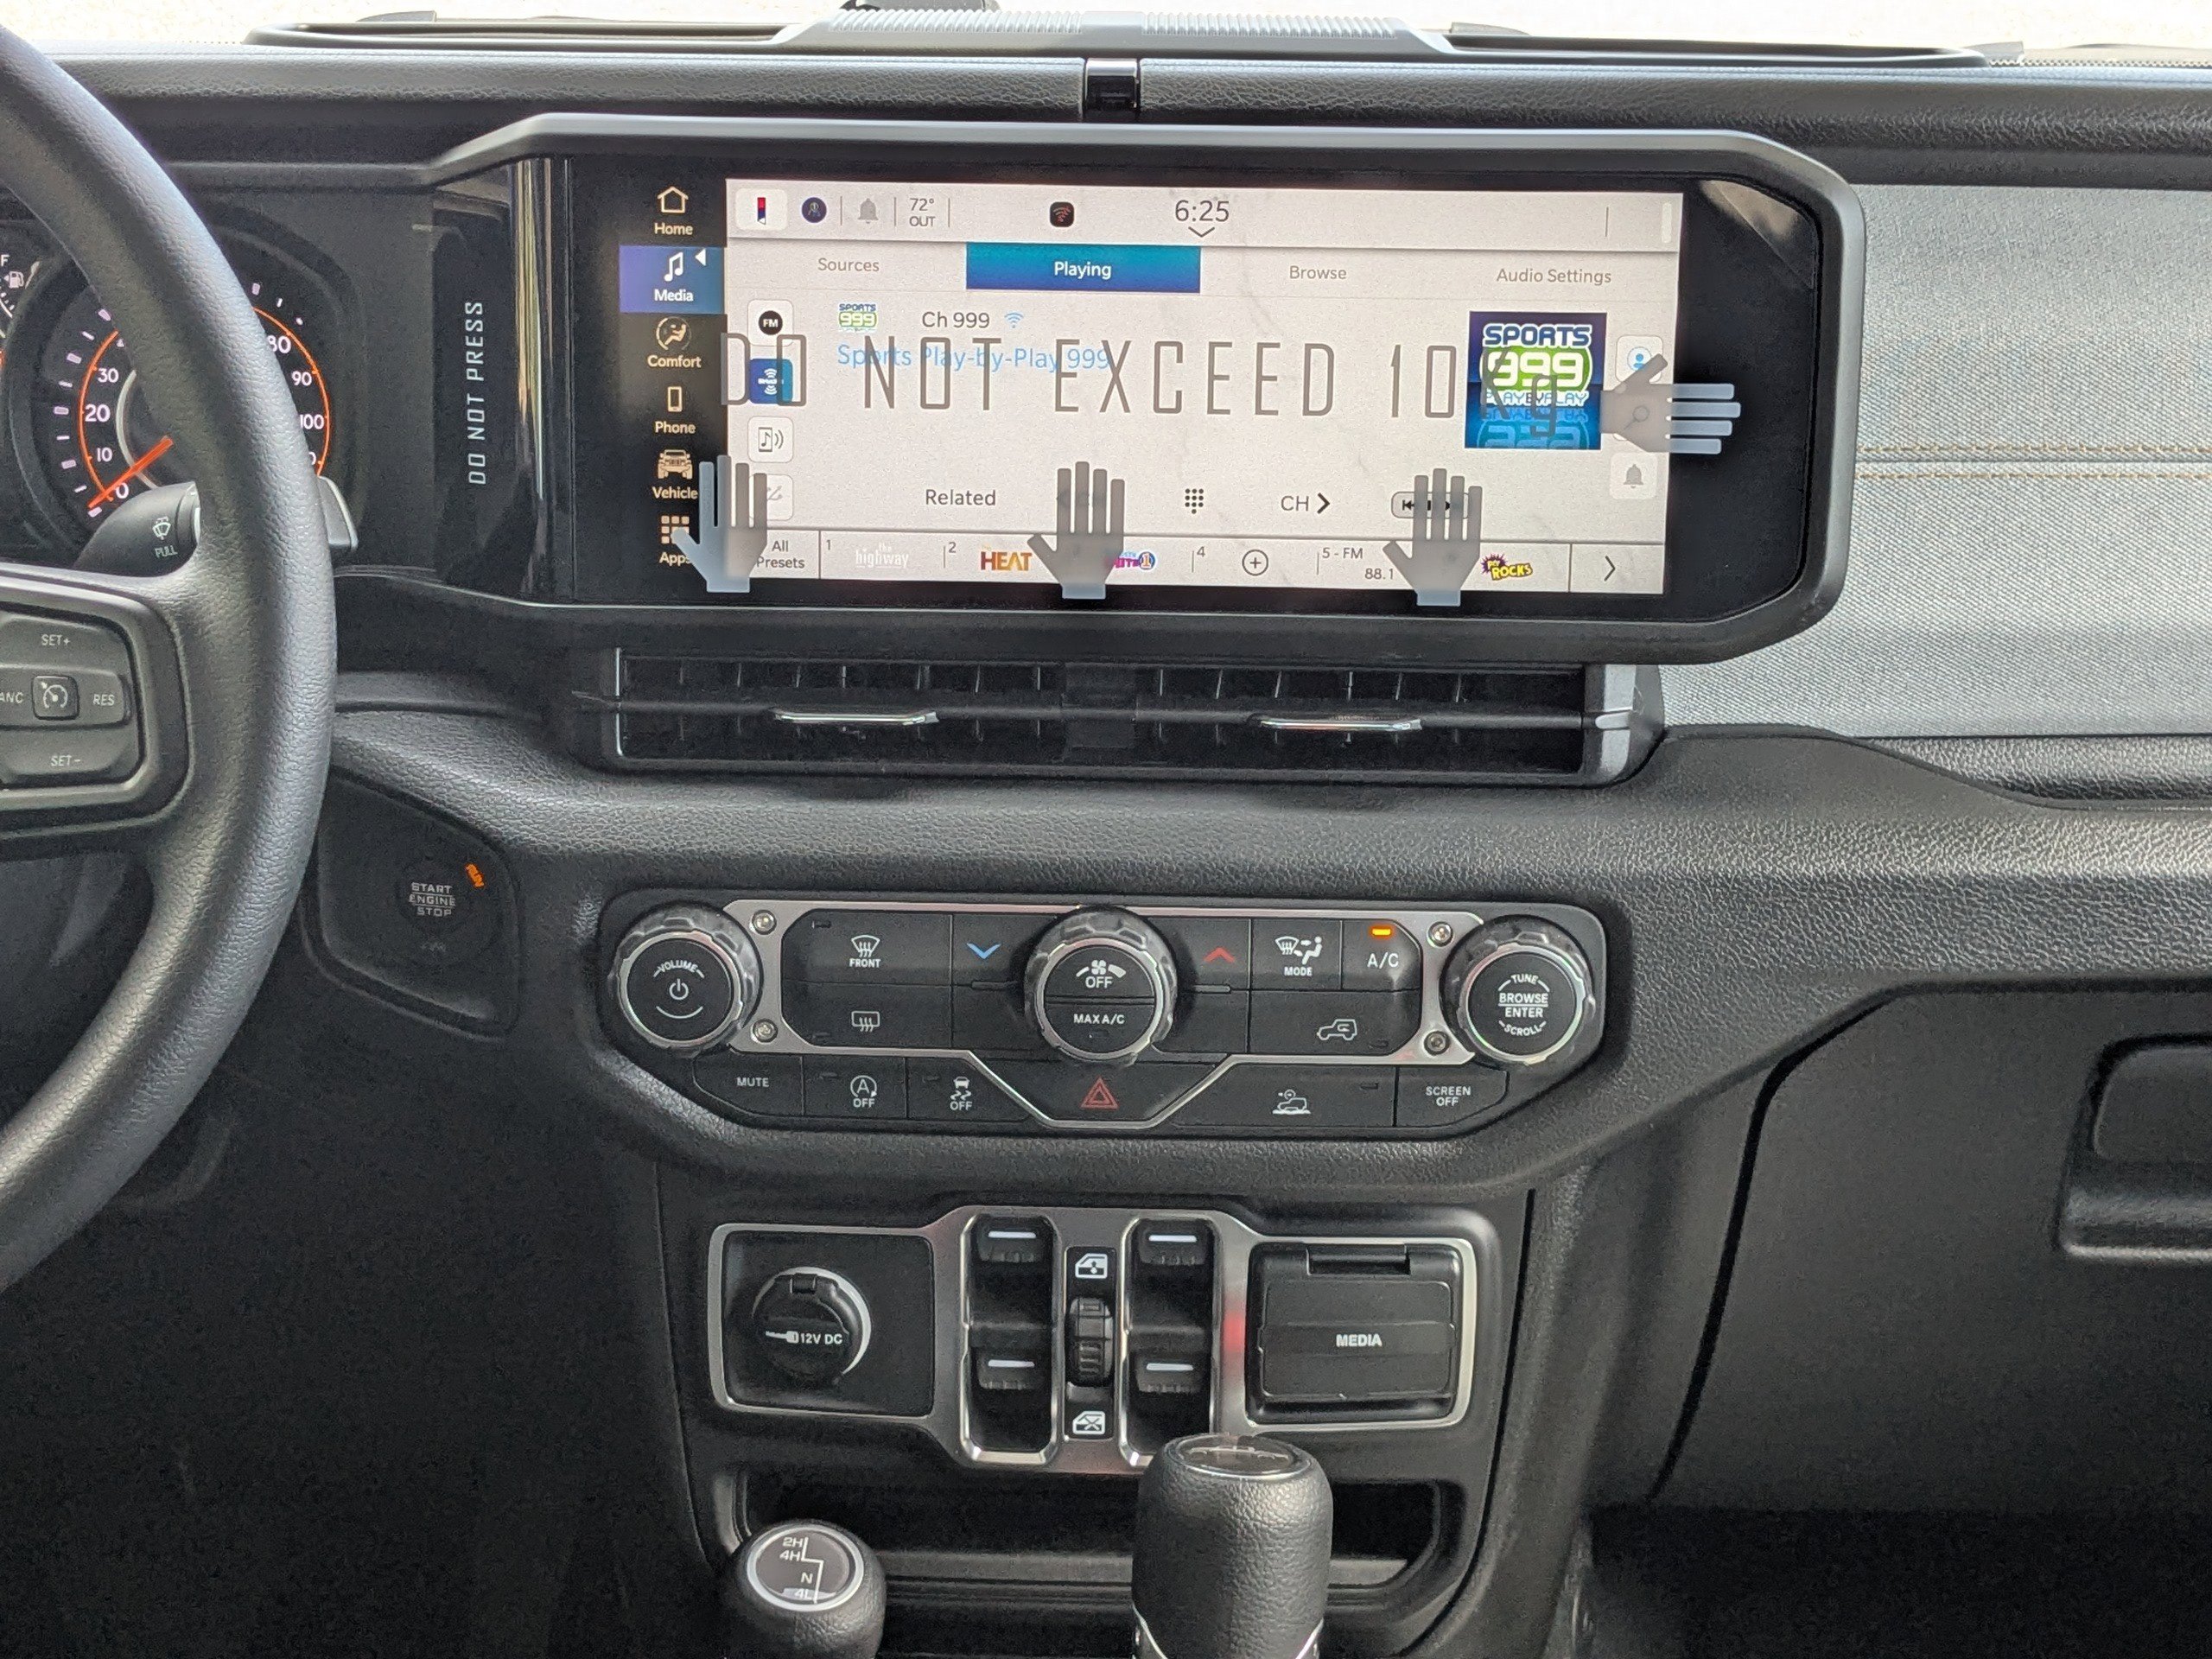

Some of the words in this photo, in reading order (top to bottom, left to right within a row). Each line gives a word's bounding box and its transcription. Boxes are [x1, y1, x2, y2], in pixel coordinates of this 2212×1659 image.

[909, 197, 934, 212] 72°
[1175, 200, 1230, 222] 6:25
[909, 215, 936, 227] OUT
[654, 222, 693, 236] Home
[1, 254, 10, 267] F
[818, 257, 880, 272] Sources
[1054, 261, 1112, 280] Playing
[1289, 265, 1347, 280] Browse
[1497, 268, 1543, 283] Audio
[1548, 268, 1612, 286] Settings
[654, 289, 694, 302] Media
[839, 303, 876, 312] SPORTS
[763, 318, 779, 328] FM
[840, 312, 876, 327] 999
[922, 311, 948, 327] Ch
[953, 312, 990, 328] 999
[465, 302, 484, 381] PRESS
[1483, 325, 1592, 347] SPORTS
[647, 354, 702, 369] Comfort
[98, 368, 118, 383] 30
[291, 370, 312, 386] 90
[721, 332, 807, 406] DO
[864, 335, 1001, 411] NOT
[1055, 338, 1336, 417] EXCEED
[1390, 344, 1457, 418] 10
[85, 404, 111, 422] 20
[467, 393, 486, 441] NOT
[300, 414, 325, 429] 100
[655, 420, 696, 435] Phone
[97, 448, 112, 462] 10
[467, 453, 486, 485] DO
[115, 482, 129, 499] 0
[652, 486, 698, 499] Vehicle
[925, 489, 996, 506] Related
[1281, 496, 1309, 512] CH
[155, 546, 177, 557] PULL
[772, 540, 789, 552] All
[949, 542, 957, 553] 2
[1197, 546, 1205, 557] 4
[855, 549, 909, 568] highway
[1323, 548, 1332, 558] 5
[1344, 548, 1363, 559] FM
[757, 557, 805, 569] Presets
[981, 551, 1033, 571] HEAT
[1365, 568, 1394, 580] 88.1
[1491, 563, 1532, 579] ROCKS
[92, 694, 115, 706] RES
[410, 881, 453, 894] START
[409, 893, 455, 906] ENGINE
[416, 906, 452, 917] STOP
[658, 959, 699, 974] VOLUME
[849, 957, 881, 969] FRONT
[1367, 955, 1400, 969] A/C
[1284, 966, 1313, 977] MODE
[1085, 976, 1113, 988] OFF
[1510, 974, 1539, 985] TUNE
[1499, 993, 1548, 1004] BROWSE
[1504, 1007, 1543, 1019] ENTER
[1073, 1014, 1100, 1025] MAX
[1102, 1014, 1125, 1026] A/C
[1503, 1022, 1542, 1037] SCROLL
[736, 1077, 770, 1089] MUTE
[1426, 1085, 1471, 1096] SCREEN
[853, 1097, 875, 1109] OFF
[950, 1100, 973, 1111] OFF
[1436, 1096, 1459, 1107] OFF
[799, 1332, 822, 1345] 12V
[824, 1332, 843, 1345] DC
[1336, 1333, 1382, 1347] MEDIA
[782, 1536, 804, 1548] 2H
[779, 1549, 801, 1561] 4H
[800, 1572, 813, 1584] N
